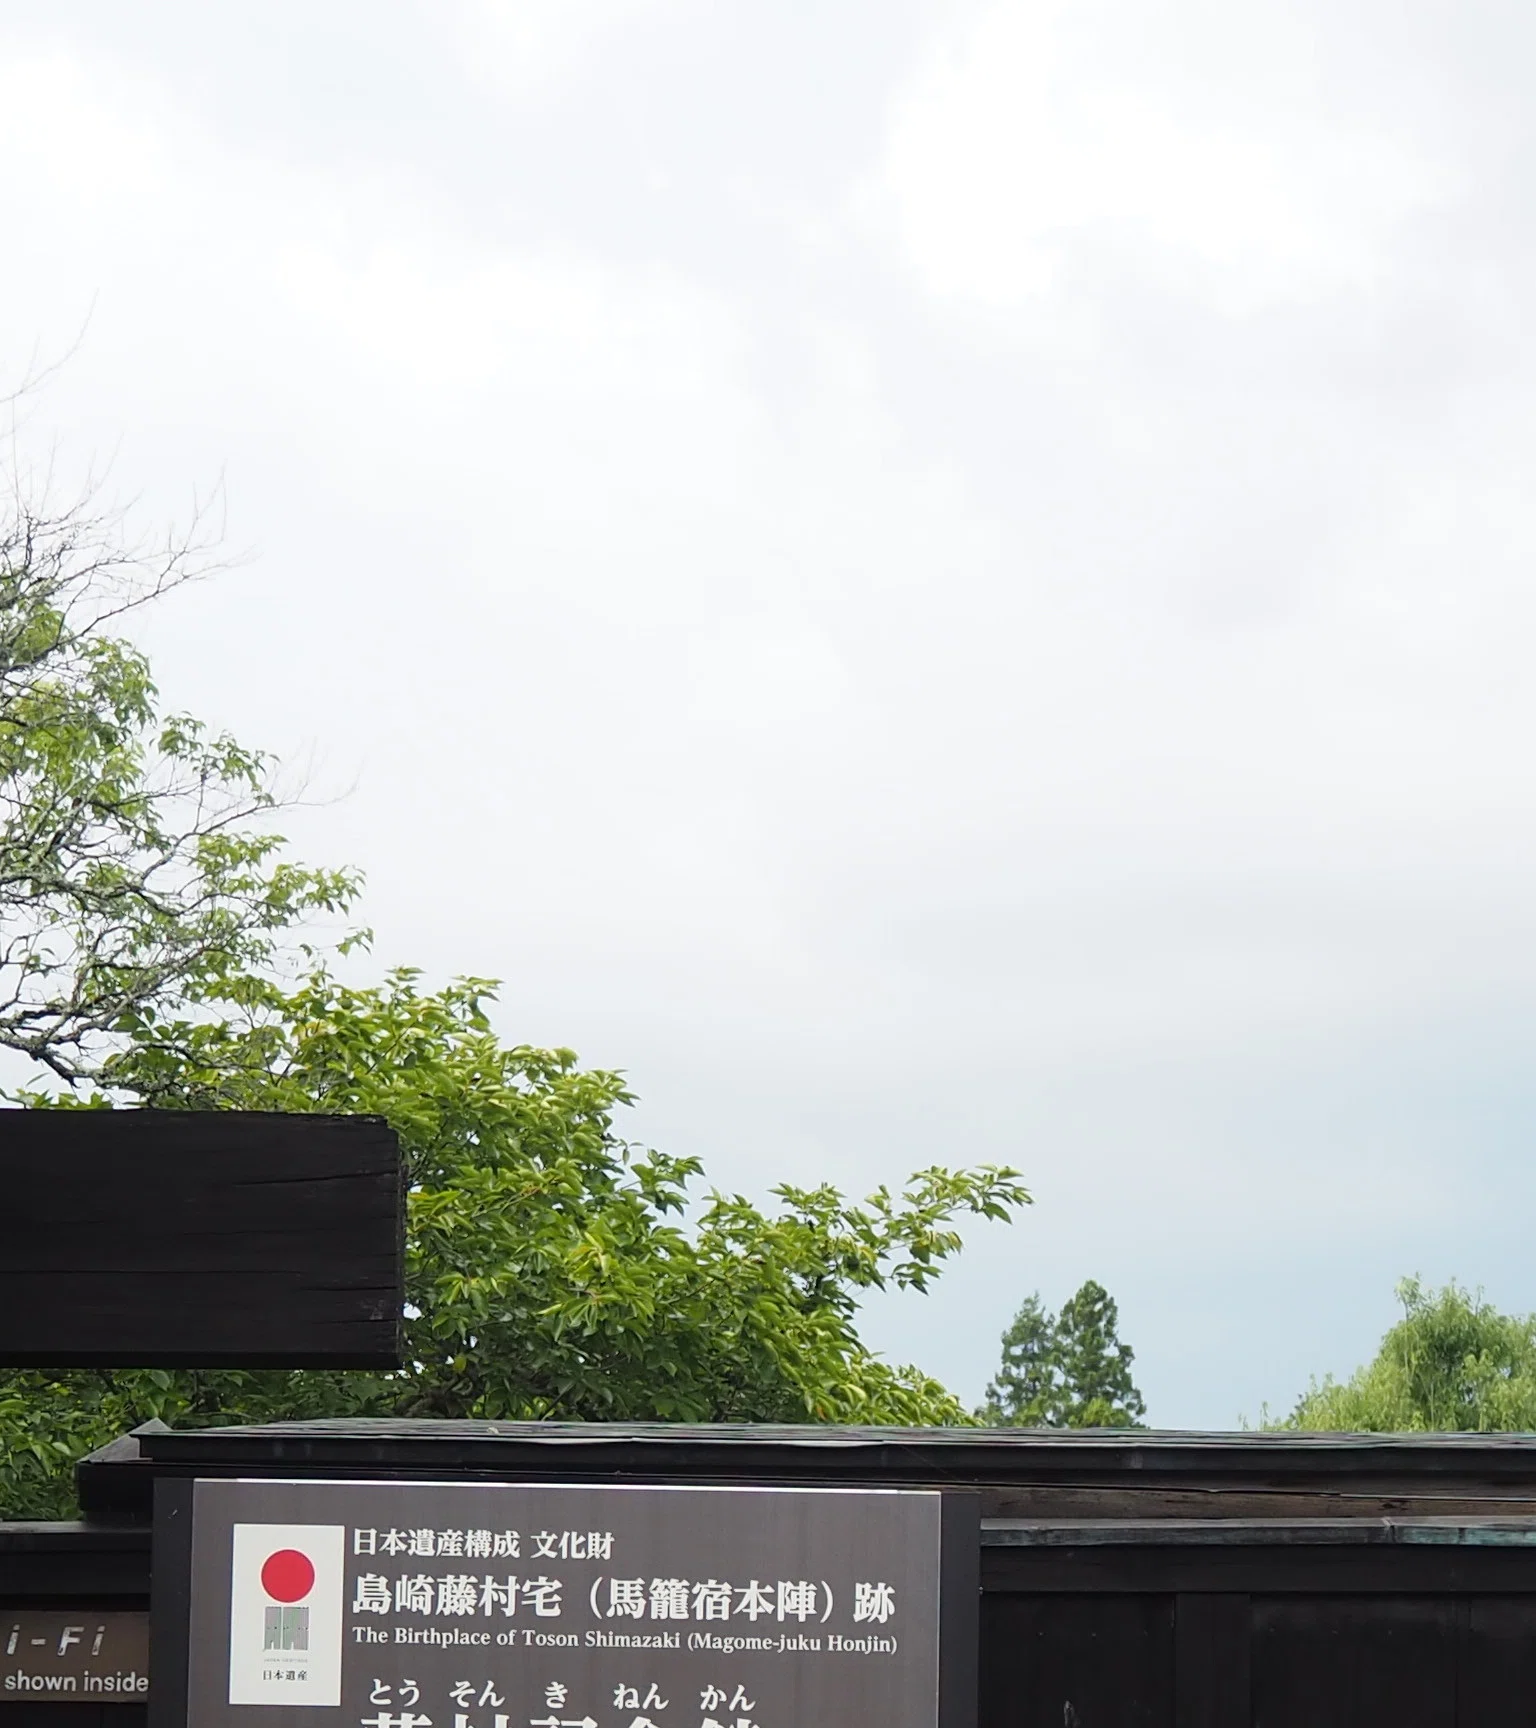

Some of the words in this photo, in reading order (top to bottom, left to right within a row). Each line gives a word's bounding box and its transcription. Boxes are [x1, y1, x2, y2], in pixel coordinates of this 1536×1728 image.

[353, 1527, 521, 1559] 日本遺産構成
[529, 1530, 616, 1561] 文化財
[351, 1626, 389, 1644] The
[394, 1627, 491, 1649] Birthplace
[496, 1628, 518, 1646] of
[521, 1629, 580, 1647] Toson
[584, 1630, 681, 1649] Shimazaki
[687, 1632, 822, 1654] (Magome-juku
[827, 1634, 898, 1656] Honjin)
[4, 1669, 77, 1692] shown
[83, 1670, 149, 1692] inside
[369, 1678, 420, 1707] とう
[448, 1679, 506, 1708] そん
[544, 1681, 569, 1709] き
[612, 1682, 670, 1710] ねん
[699, 1684, 756, 1712] かん
